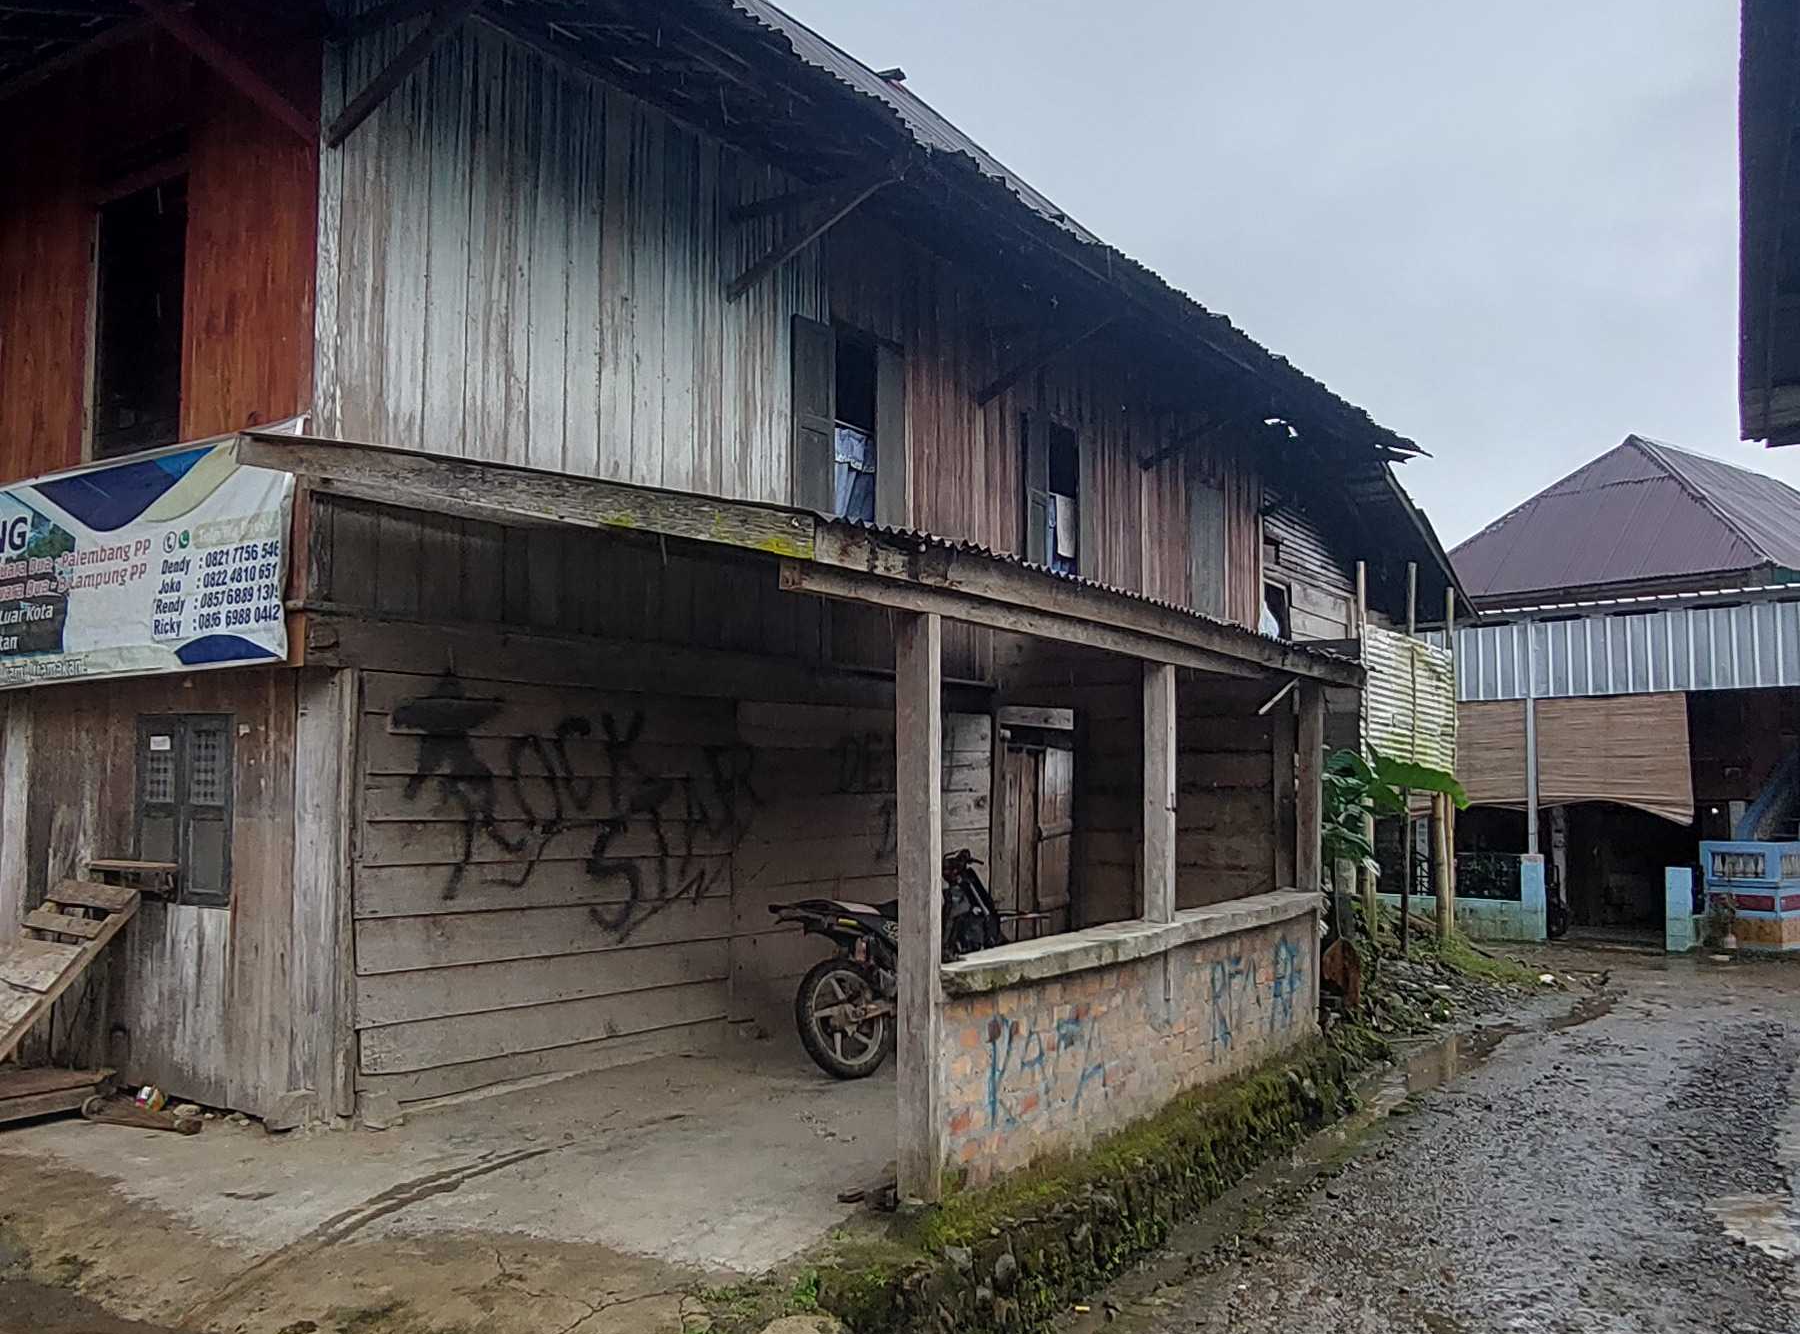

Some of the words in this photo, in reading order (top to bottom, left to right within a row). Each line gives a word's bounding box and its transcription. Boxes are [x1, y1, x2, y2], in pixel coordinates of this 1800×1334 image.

[61, 545, 131, 567] Palembang
[134, 539, 151, 556] PP
[161, 556, 191, 576] Dendy
[205, 548, 230, 568] 0821
[130, 563, 147, 581] PP
[158, 577, 182, 595] Joko
[203, 569, 228, 588] 0822
[230, 565, 256, 584] 4810
[26, 604, 53, 622] Kota
[154, 617, 182, 637] Ricky
